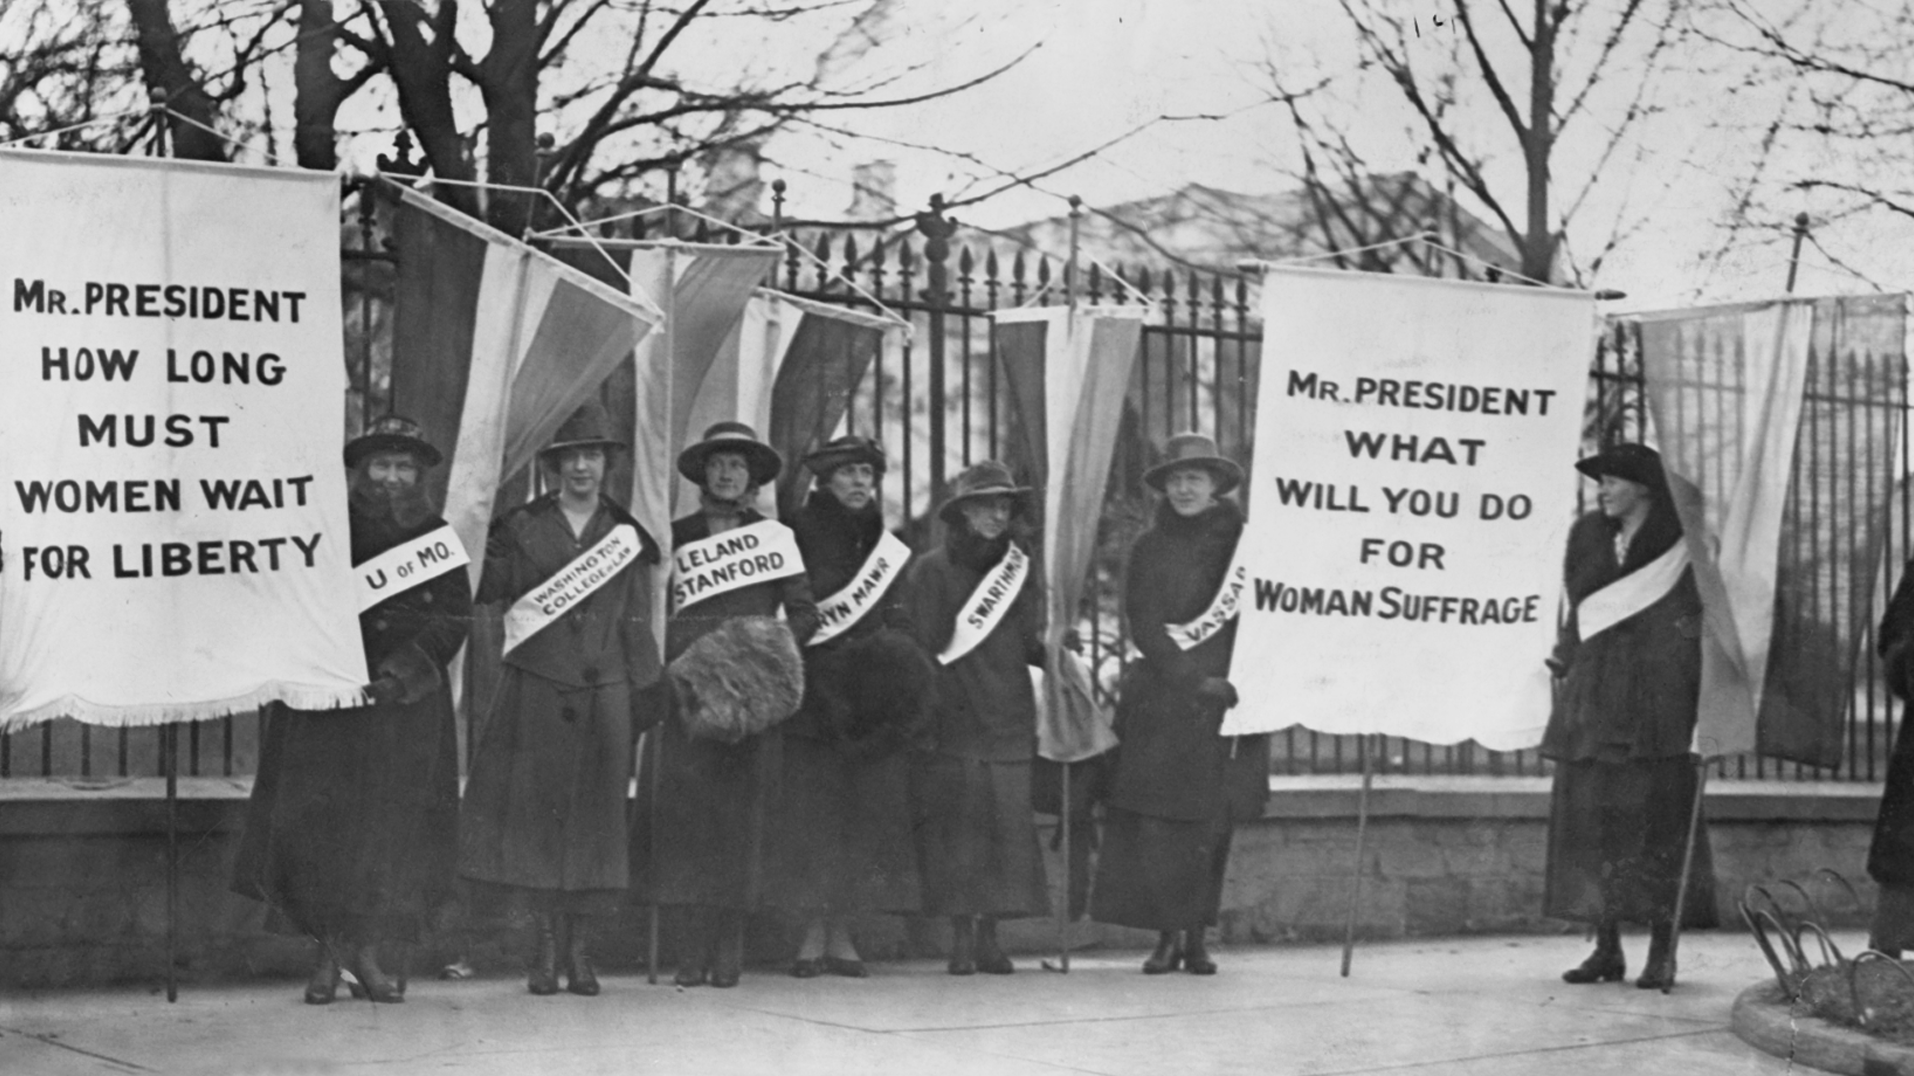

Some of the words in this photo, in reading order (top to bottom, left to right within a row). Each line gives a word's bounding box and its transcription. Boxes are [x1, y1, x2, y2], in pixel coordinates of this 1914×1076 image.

[85, 281, 307, 323] PRESIDENT
[41, 346, 139, 382] HOW
[166, 348, 287, 386] LONG
[1354, 377, 1557, 416] PRESIDENT
[77, 414, 230, 448] MUST
[1344, 429, 1486, 466] WHAT
[14, 479, 181, 514] WOMEN
[199, 474, 314, 511] WAIT
[1275, 476, 1370, 513] WILL
[1381, 486, 1460, 519] YOU
[1479, 493, 1532, 521] DO
[22, 544, 91, 581] FOR
[113, 533, 322, 578] LIBERTY
[676, 533, 759, 574] LELAND
[1359, 538, 1446, 571] FOR
[365, 568, 388, 590] U
[674, 551, 784, 604] STANFORD
[818, 601, 852, 630] RYN
[852, 557, 890, 606] MAWR
[1254, 577, 1373, 617] WOMAN
[1376, 585, 1541, 625] SUFFRAGE
